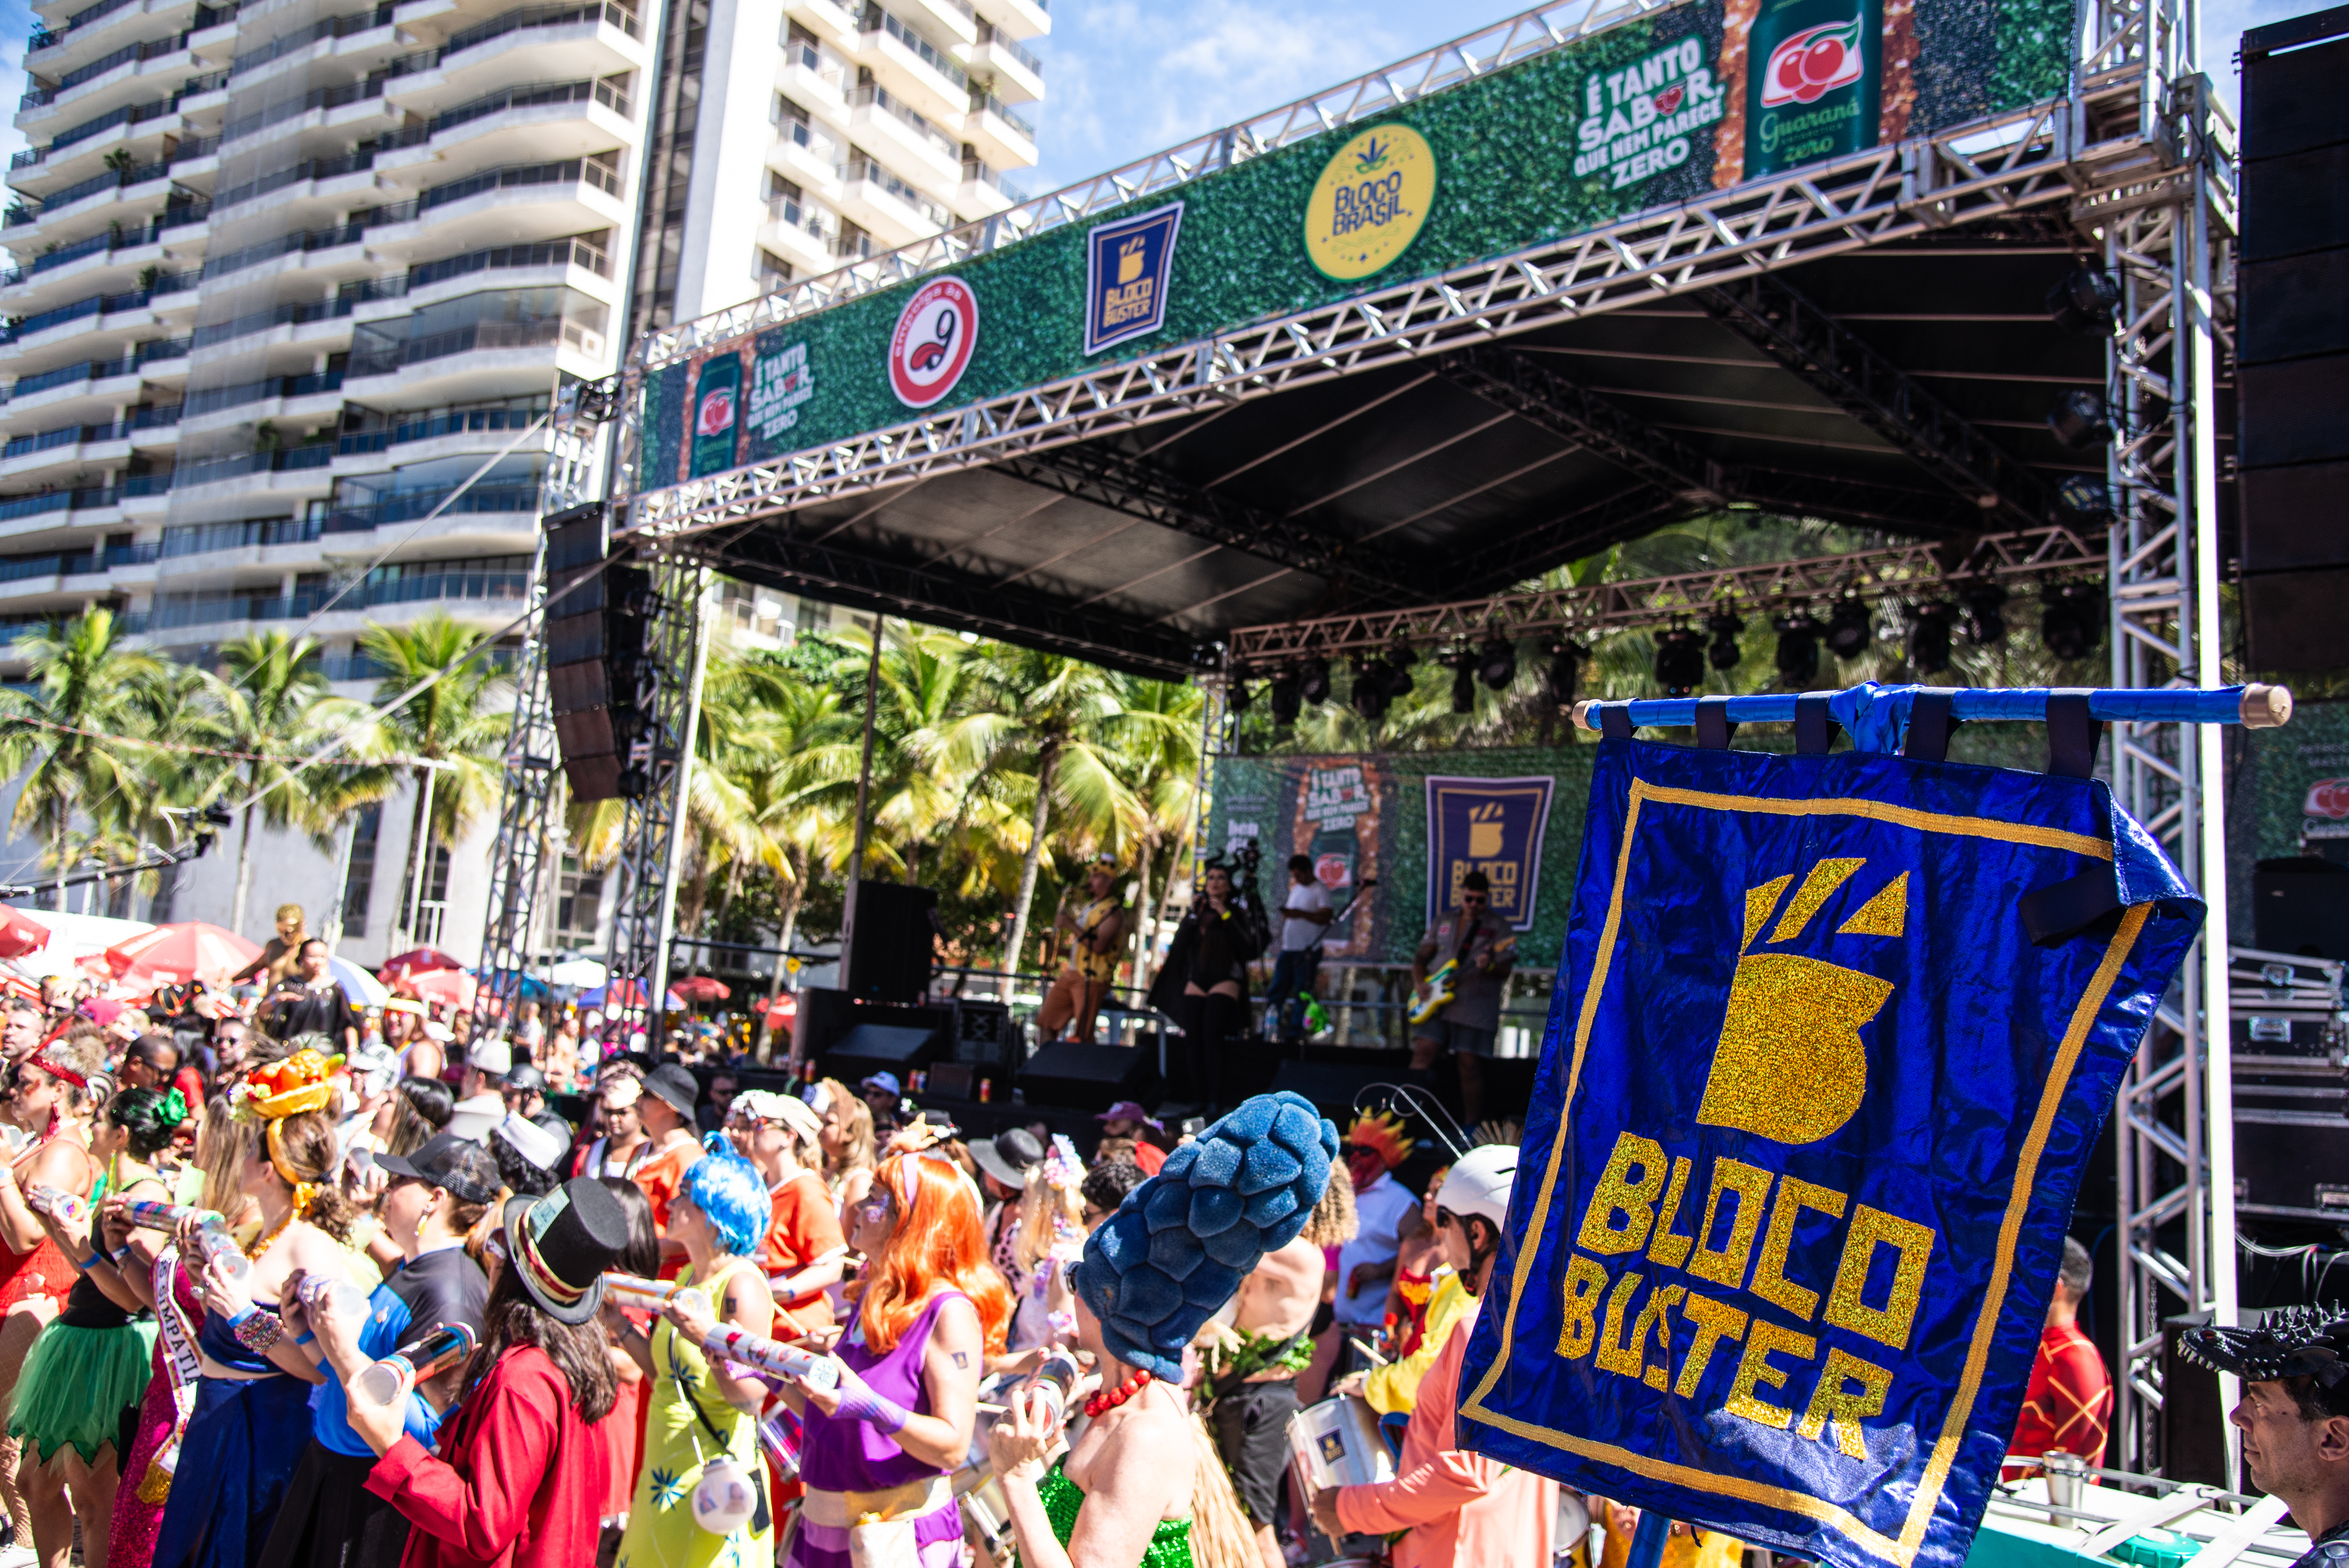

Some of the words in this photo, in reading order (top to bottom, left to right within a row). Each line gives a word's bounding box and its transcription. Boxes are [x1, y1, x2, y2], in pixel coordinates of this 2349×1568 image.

[1587, 73, 1603, 117] É
[1606, 38, 1701, 107] TANTO
[1574, 146, 1610, 177] QUE
[1611, 127, 1650, 161] NEM
[1652, 97, 1723, 144] PARECE
[1610, 137, 1690, 190] ZERO
[1335, 171, 1402, 212] BLOCO
[1332, 194, 1405, 236] BRASIL
[1103, 298, 1152, 328] BUSTER
[1105, 277, 1153, 308] BLOCO
[765, 342, 807, 383] TANTO
[763, 408, 798, 440] ZERO
[1577, 1131, 1936, 1350] BLOCO
[1554, 1253, 1893, 1460] BUSTER
